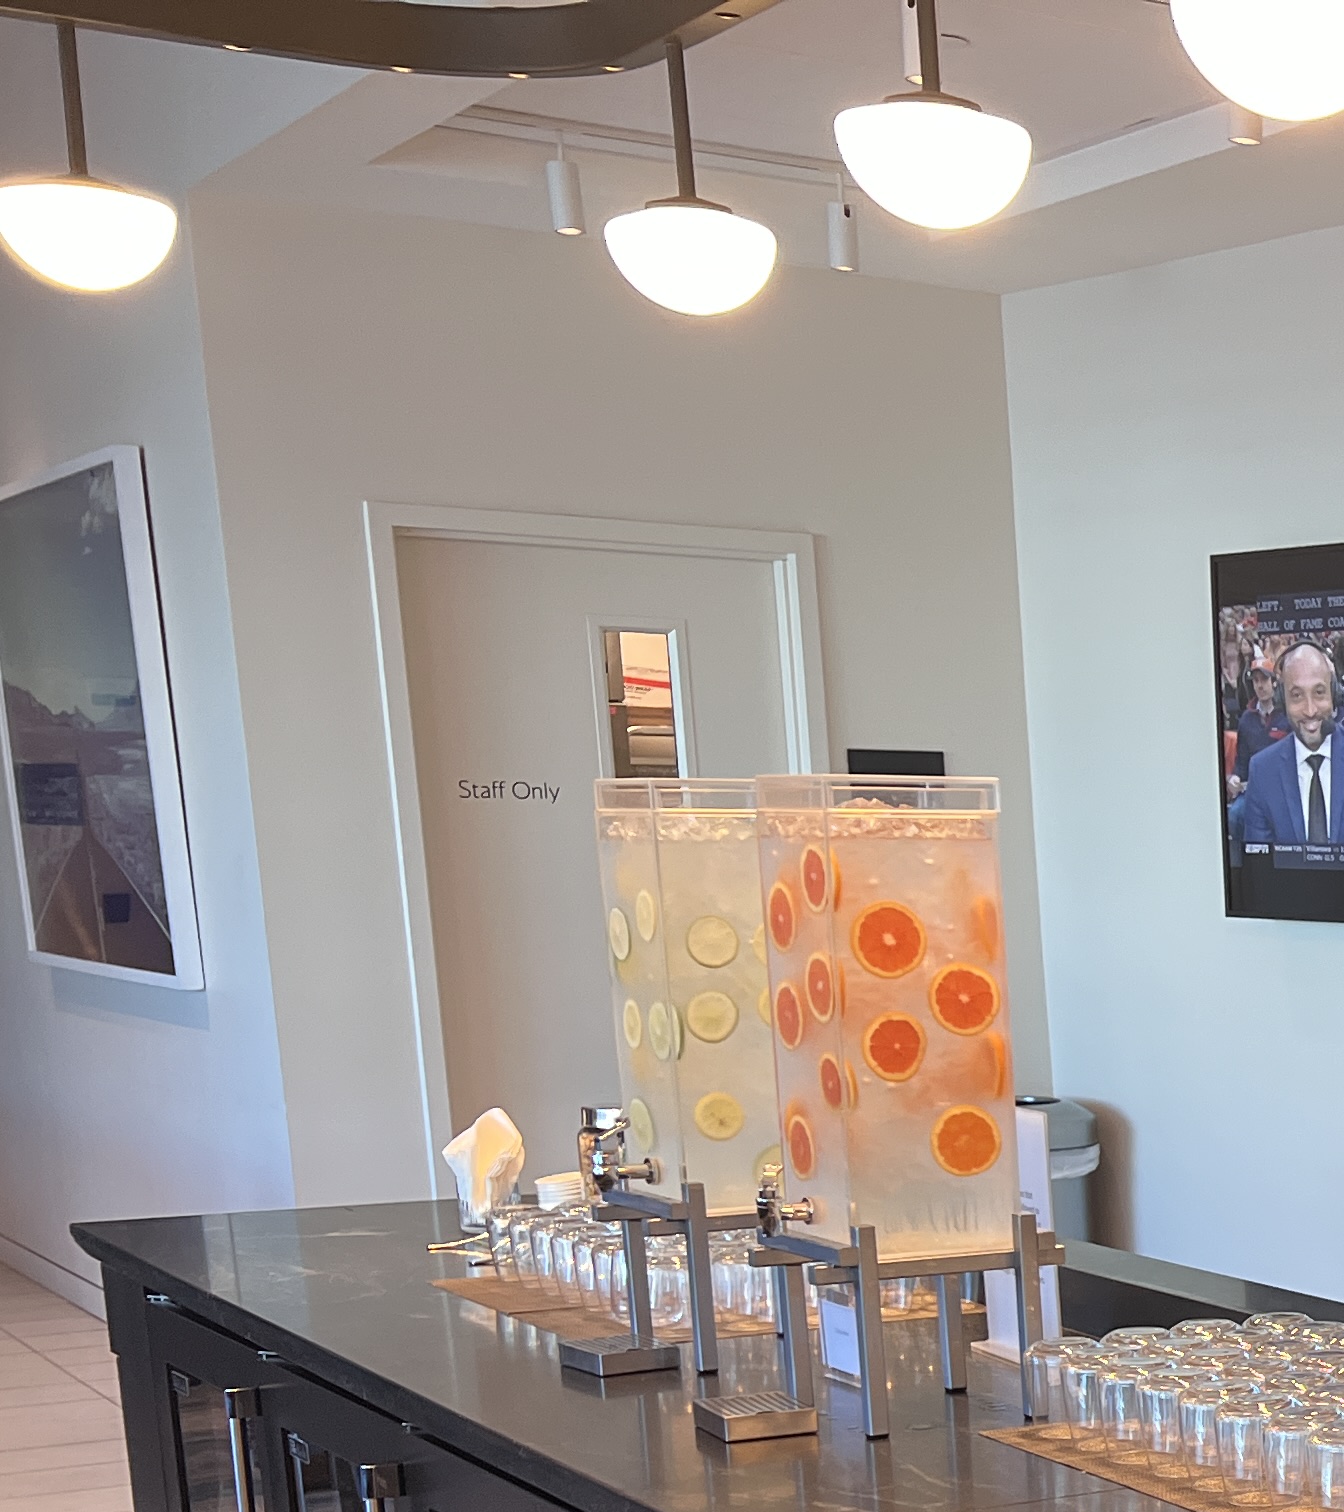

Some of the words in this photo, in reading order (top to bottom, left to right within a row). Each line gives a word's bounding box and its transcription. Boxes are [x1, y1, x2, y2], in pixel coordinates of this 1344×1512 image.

[1256, 601, 1283, 612] LEFT.
[1294, 598, 1322, 610] TODAY
[1284, 620, 1295, 631] OF
[1301, 619, 1323, 630] FAME
[459, 780, 506, 799] Staff
[512, 782, 560, 804] Only
